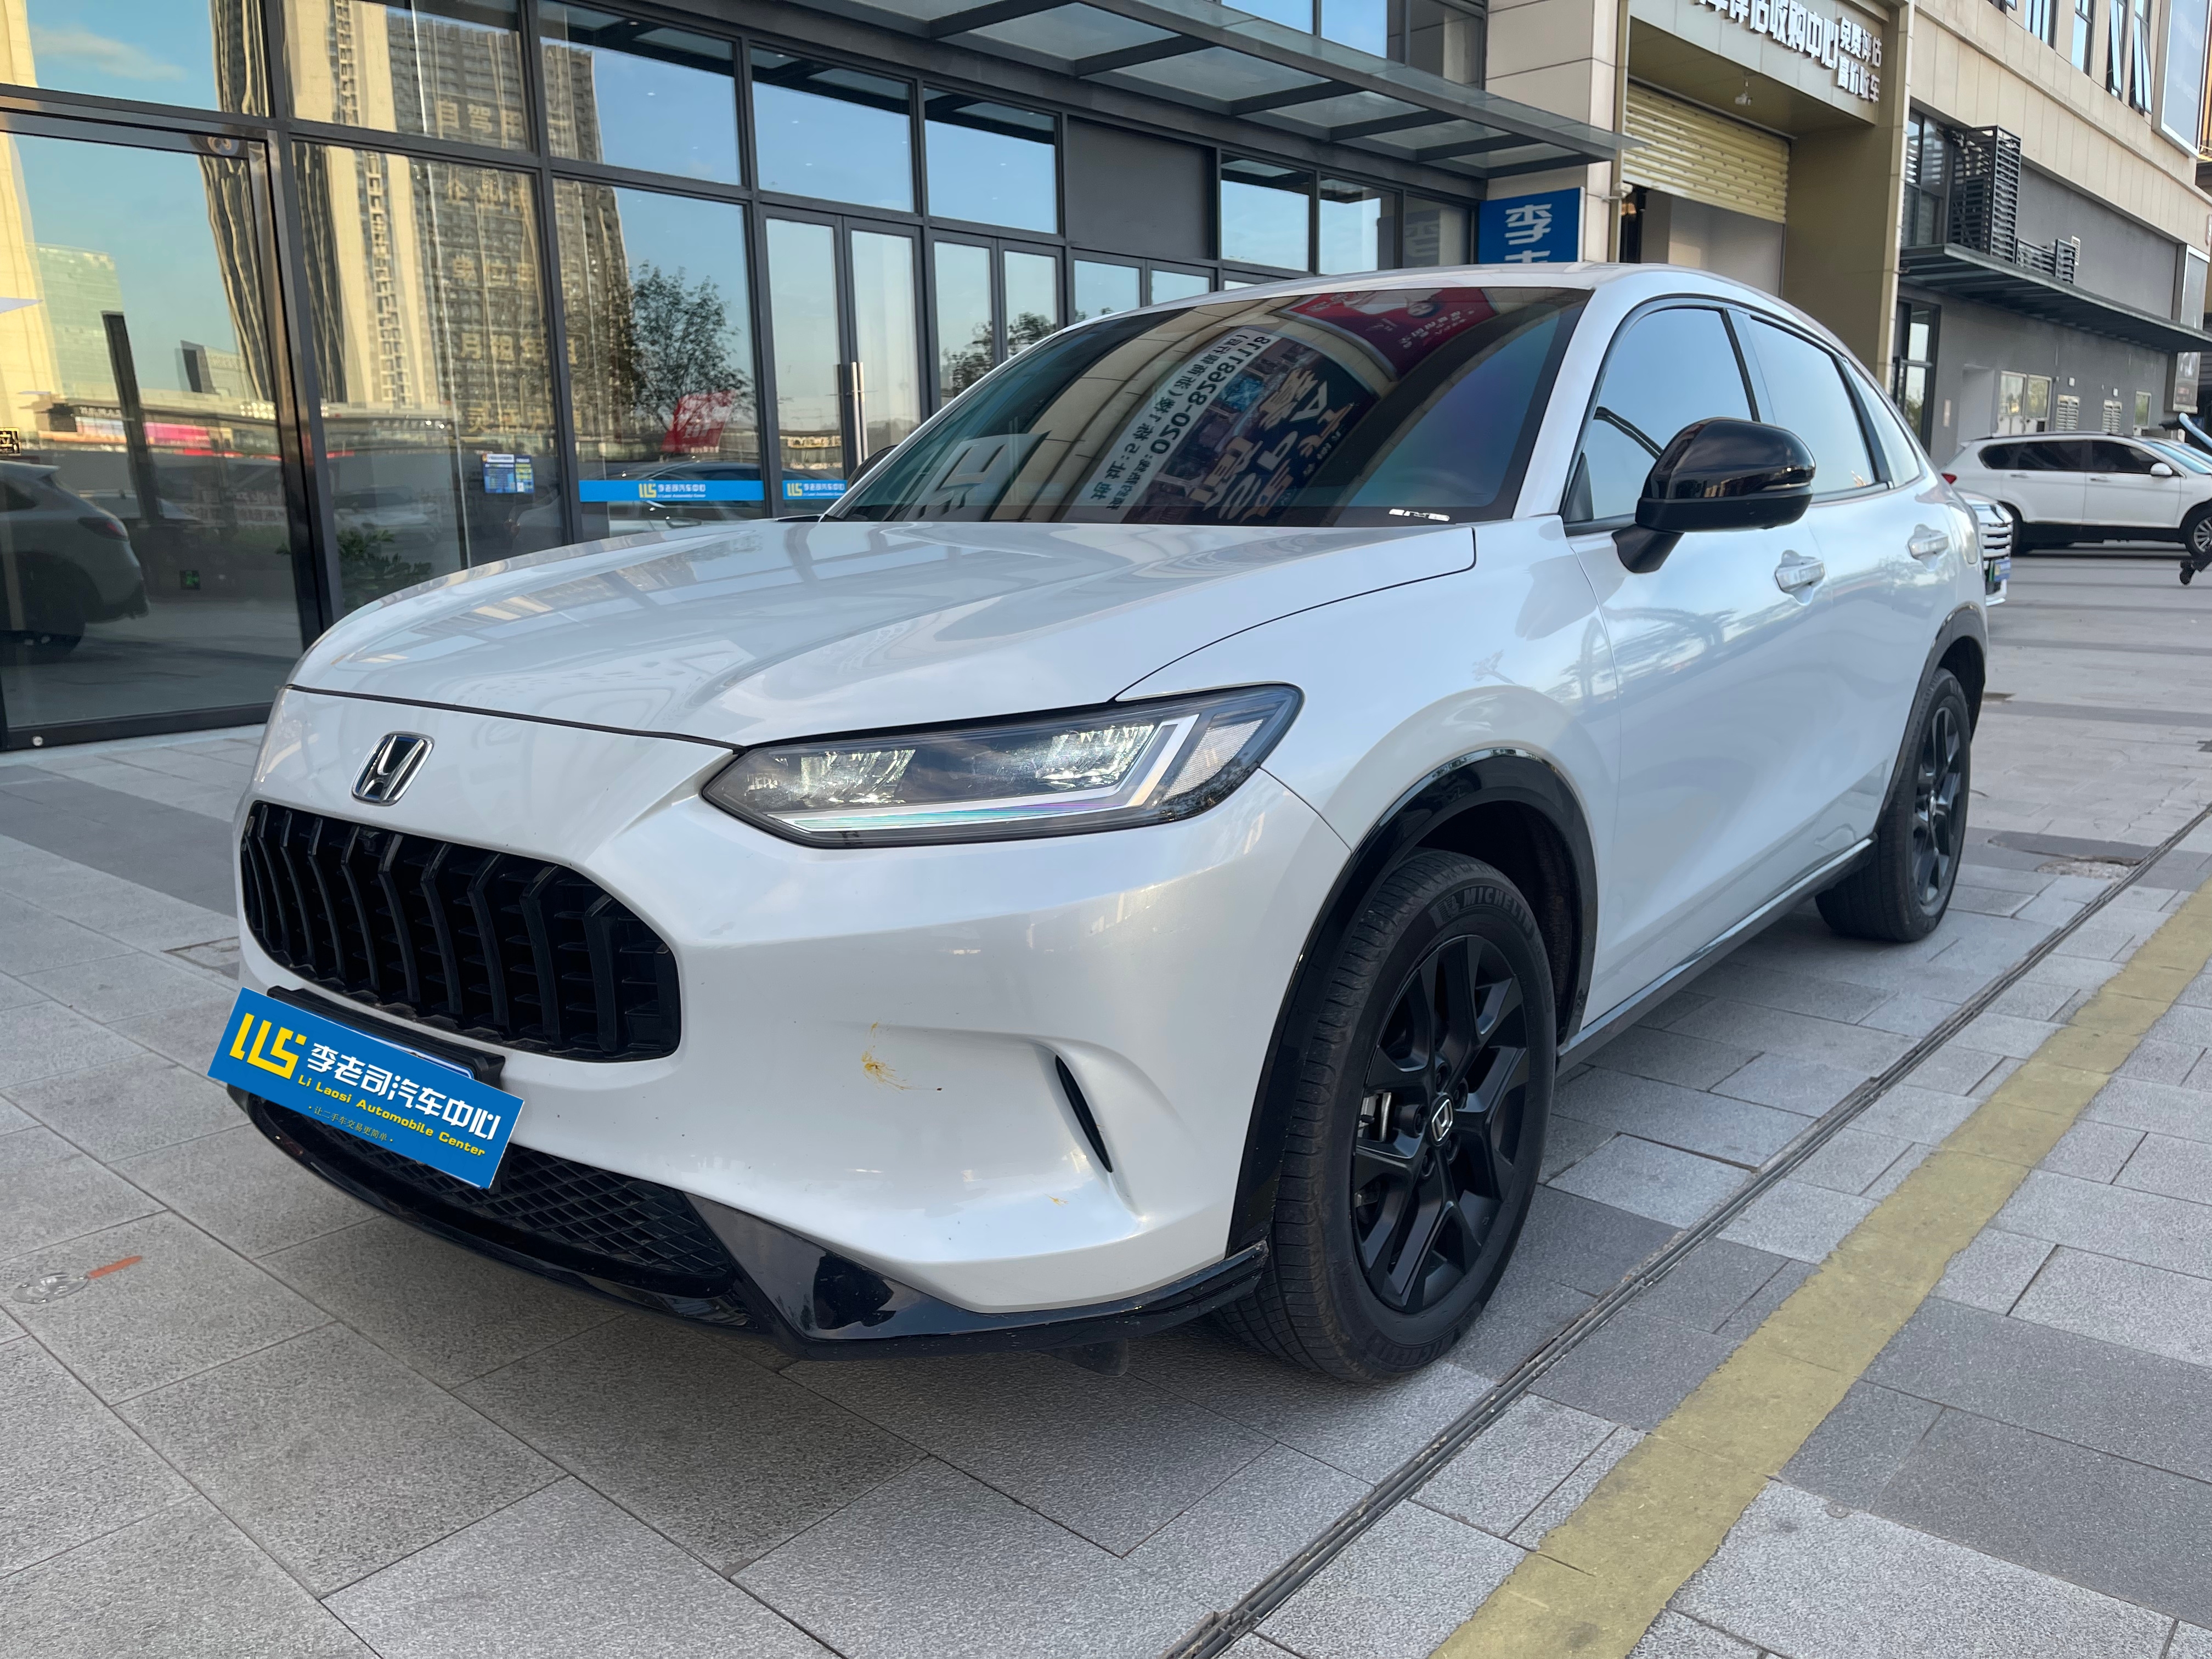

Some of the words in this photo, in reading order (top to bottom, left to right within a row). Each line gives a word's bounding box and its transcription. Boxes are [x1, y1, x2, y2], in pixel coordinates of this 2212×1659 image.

[1839, 16, 1882, 68] 免费评估
[1837, 55, 1880, 103] 高价收车
[1463, 887, 1534, 935] MICHELIN
